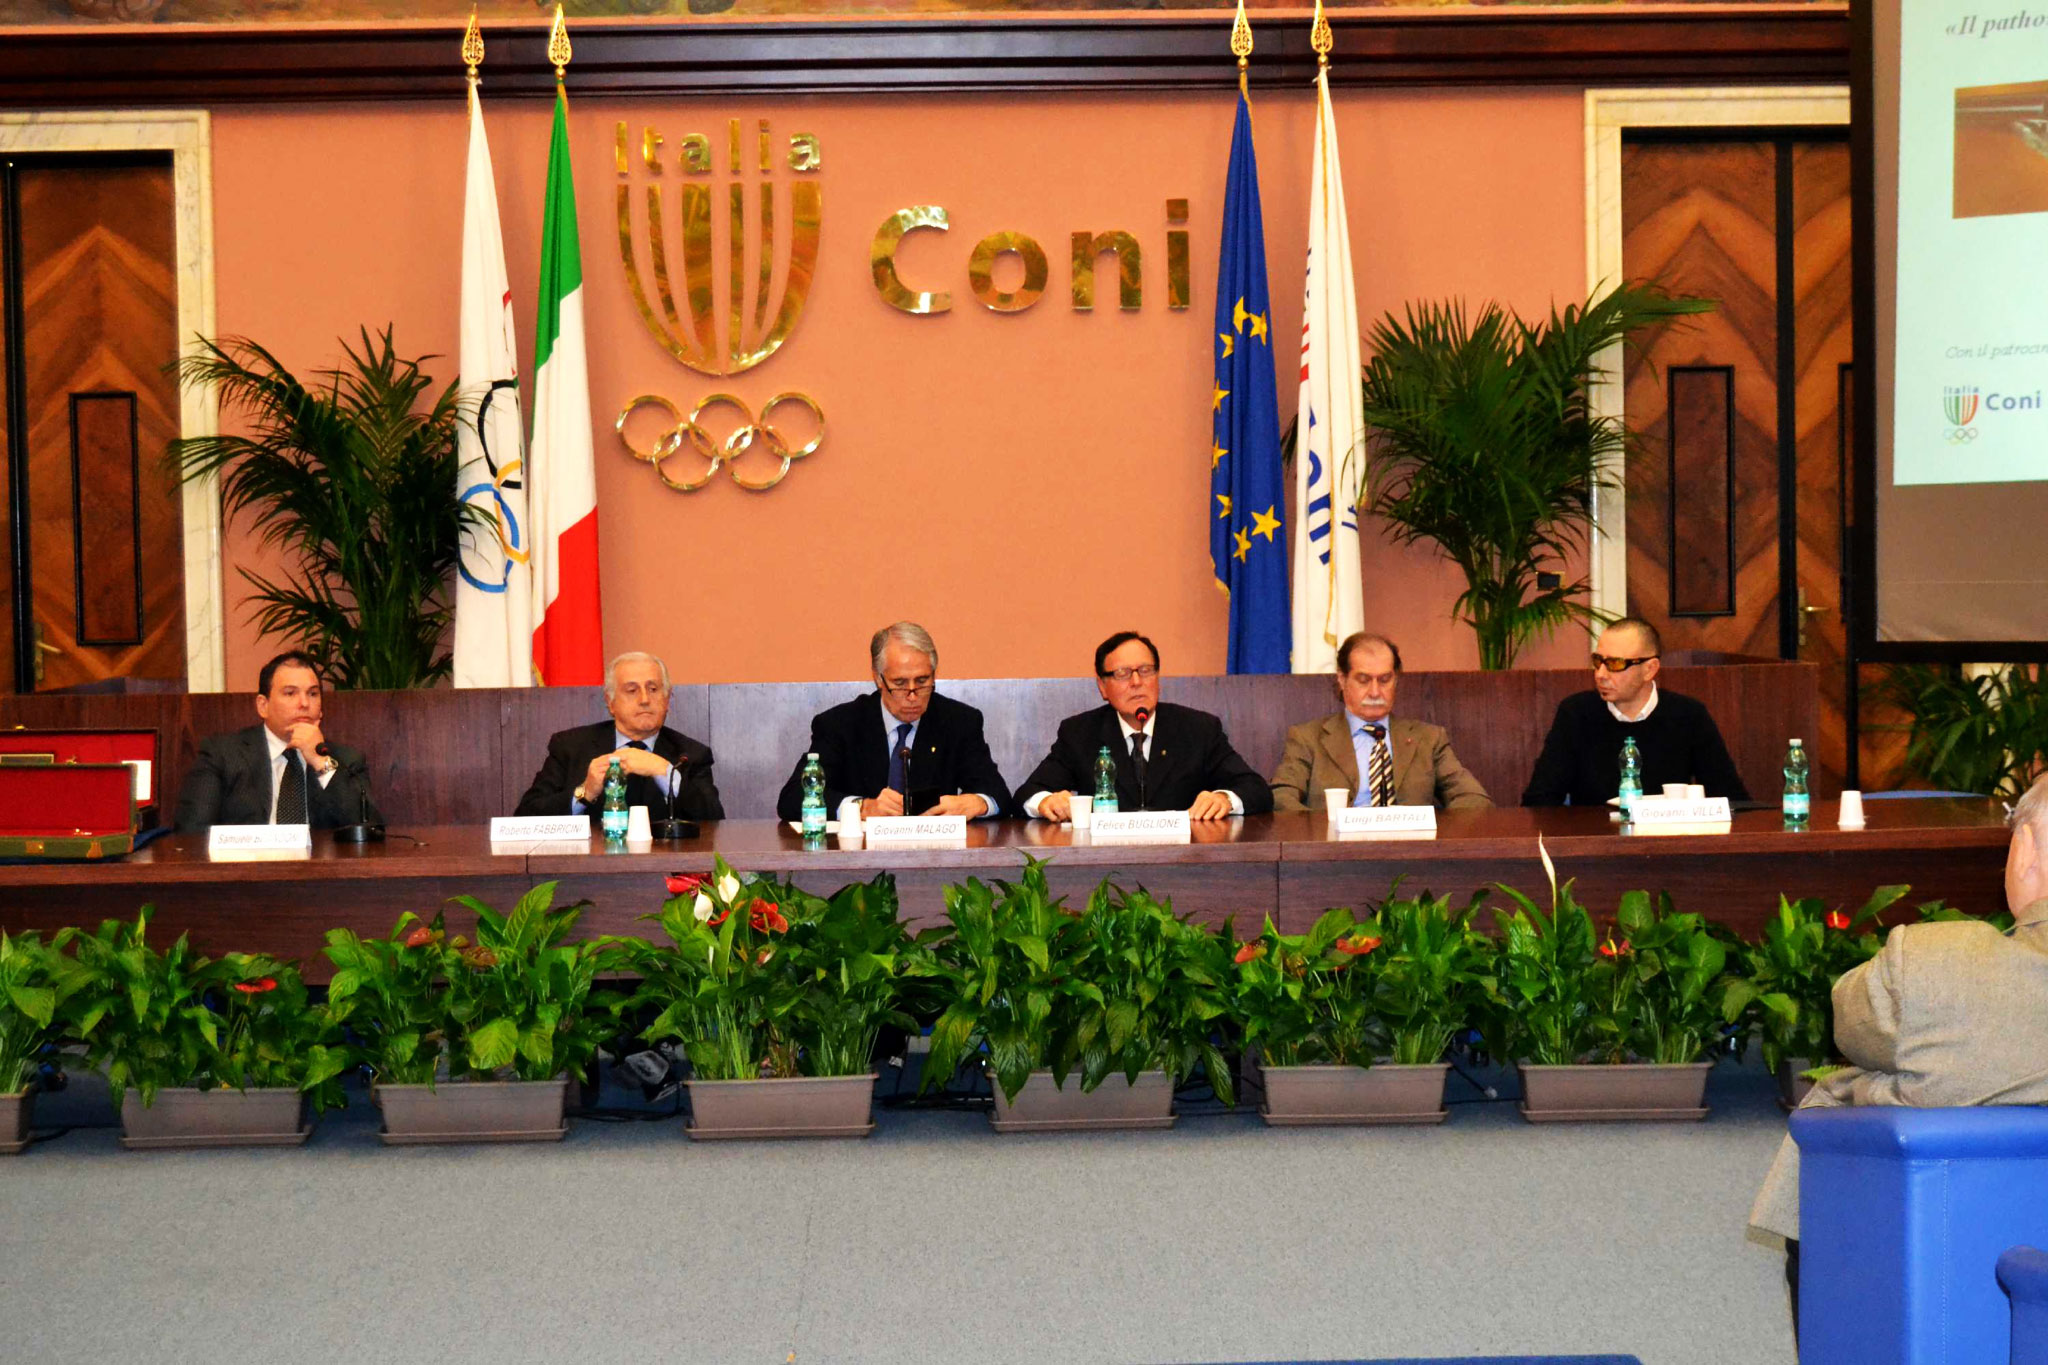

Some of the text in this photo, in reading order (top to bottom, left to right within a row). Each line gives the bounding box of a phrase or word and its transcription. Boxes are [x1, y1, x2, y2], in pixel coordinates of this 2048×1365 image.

[1980, 9, 2048, 38] patho
[616, 118, 821, 174] Italia
[870, 198, 1190, 314] Coni
[1945, 345, 1973, 359] Con
[1977, 343, 1988, 358] il
[1985, 389, 2041, 410] Coni
[1692, 805, 1723, 817] VILLA
[1096, 818, 1181, 830] Felice BUGLIONE
[1344, 815, 1372, 825] Luigi
[499, 823, 583, 836] Roberto FABBRICINI
[874, 823, 960, 835] Giovanni MALAGO'
